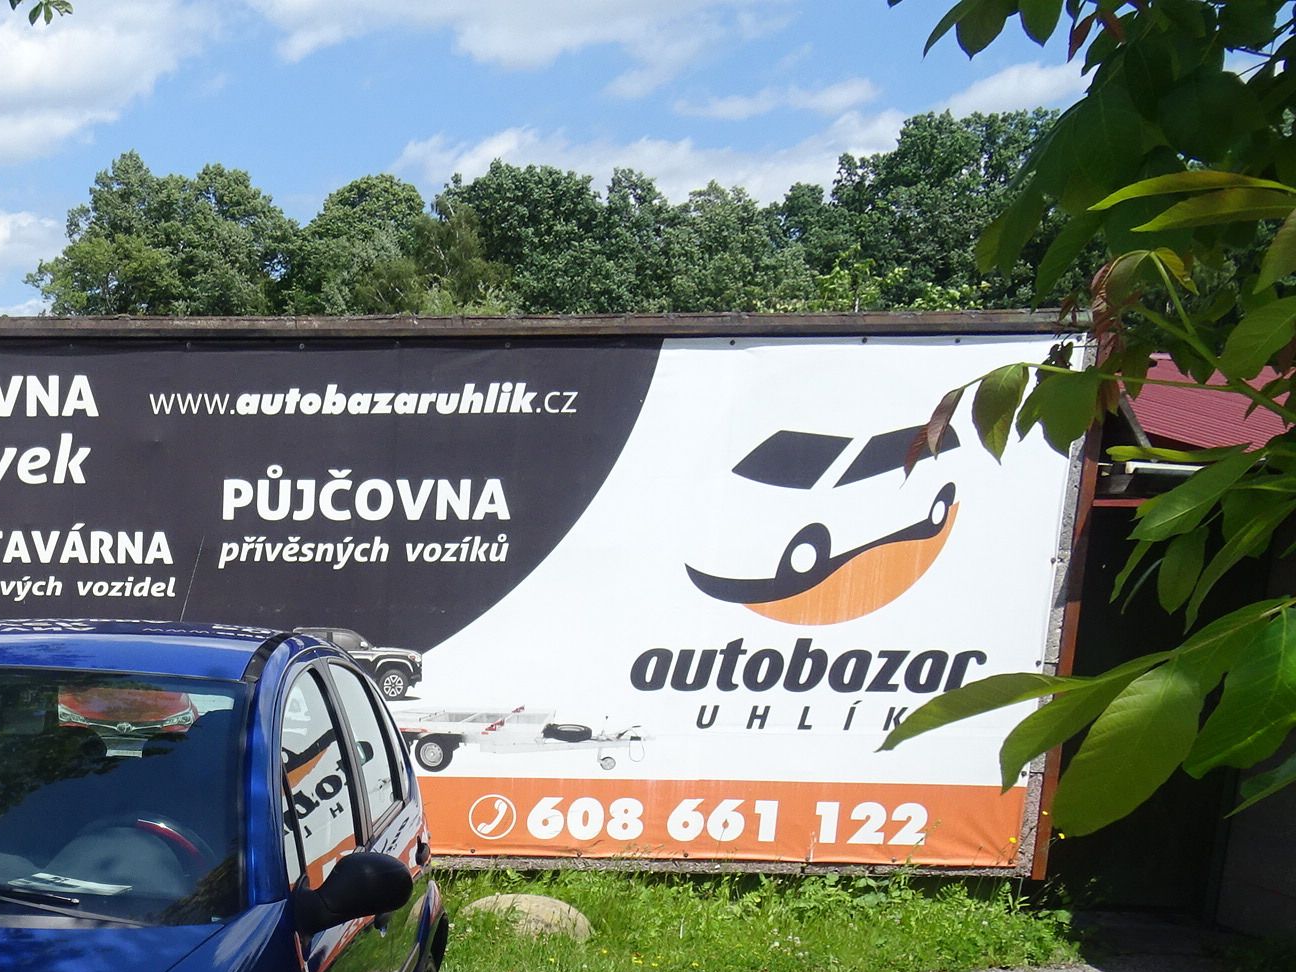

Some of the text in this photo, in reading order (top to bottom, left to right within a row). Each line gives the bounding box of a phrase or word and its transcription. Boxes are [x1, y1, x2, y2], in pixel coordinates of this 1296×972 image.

[149, 382, 579, 416] www.autobazaruhlik.cz
[222, 464, 511, 521] PŮJČOVNA
[217, 533, 510, 570] přívěsných vozíků
[76, 576, 176, 598] vozidel
[630, 637, 988, 693] autobazar
[526, 796, 929, 845] 608 661 122
